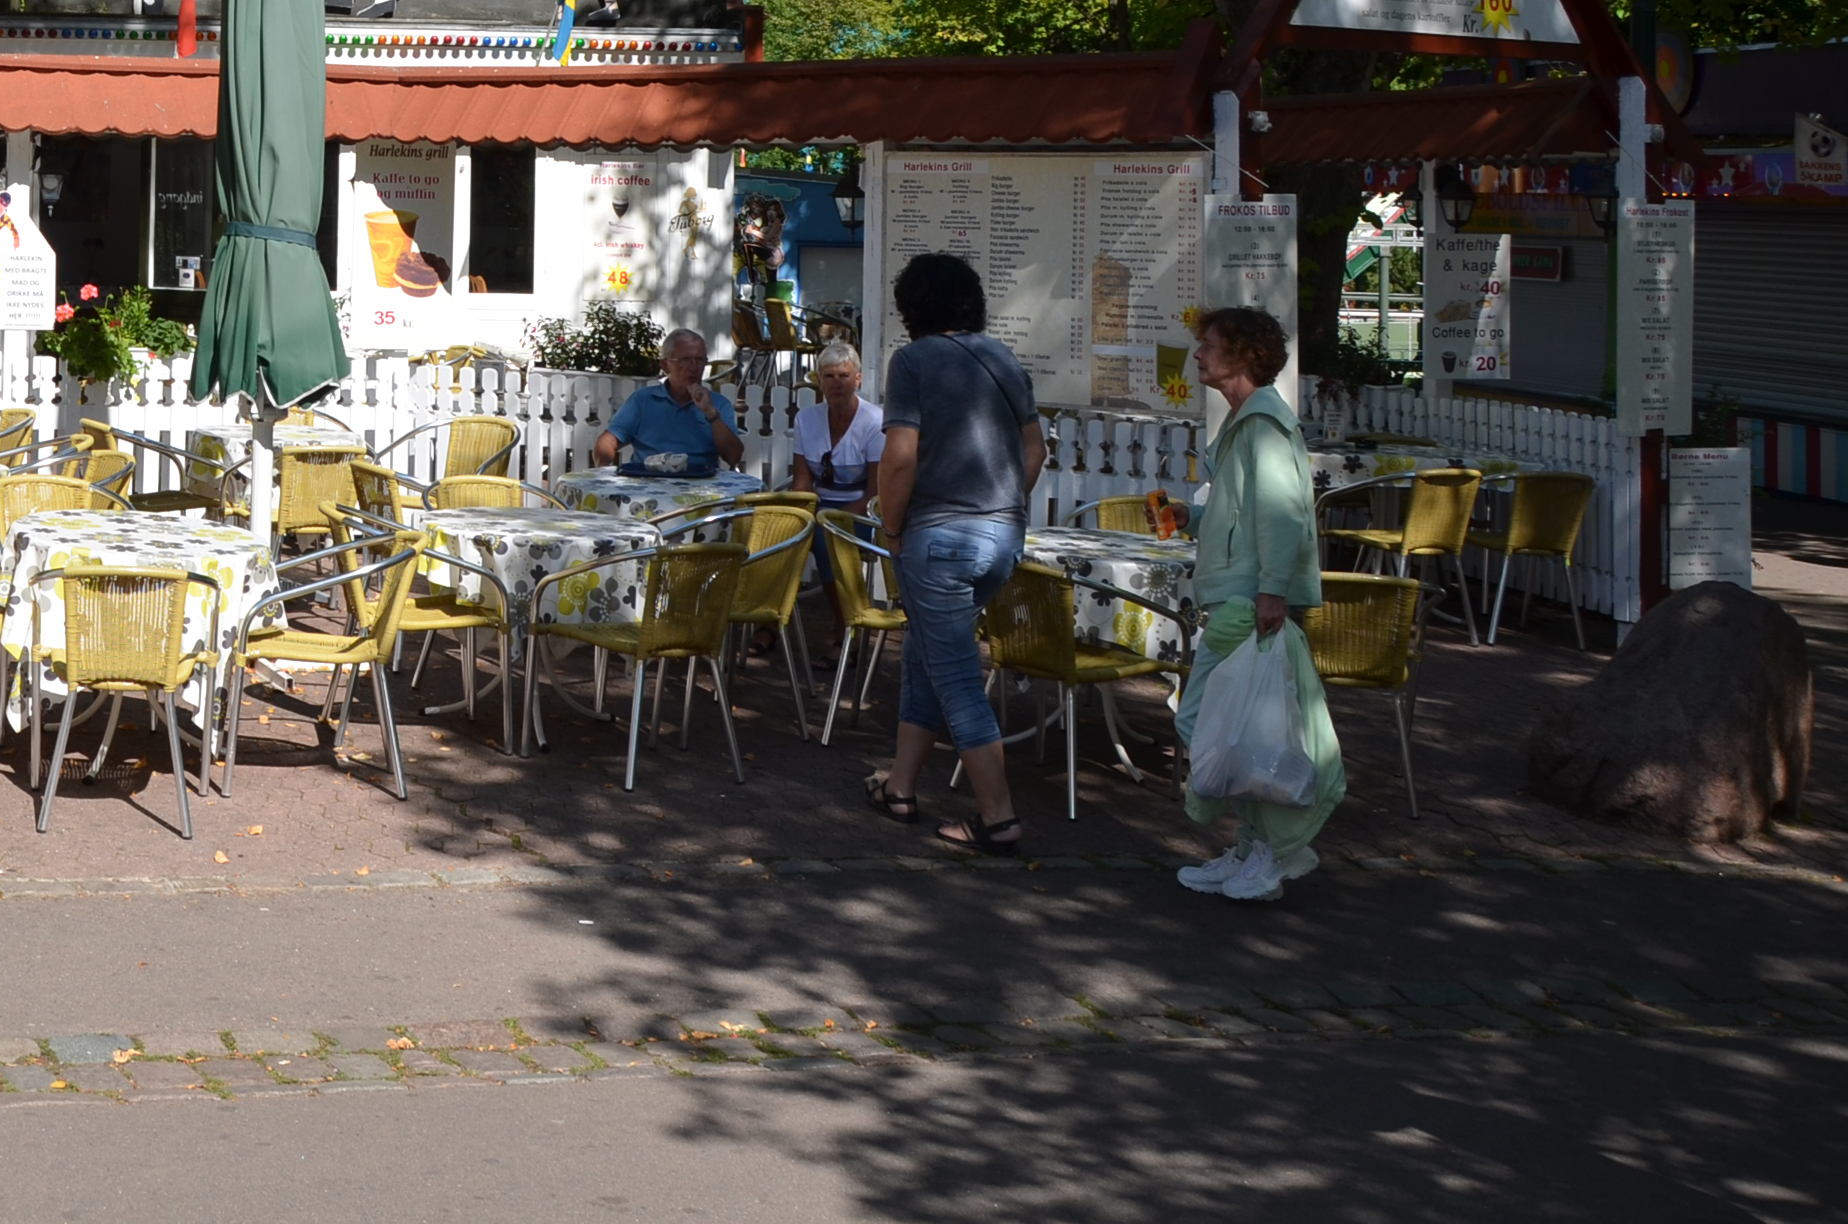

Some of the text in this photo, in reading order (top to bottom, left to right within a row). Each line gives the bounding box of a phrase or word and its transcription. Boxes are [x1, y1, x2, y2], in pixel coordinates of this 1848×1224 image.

[1362, 8, 1378, 17] salat
[1380, 11, 1390, 20] og
[1391, 11, 1416, 22] dagens
[1462, 14, 1479, 33] Kr.
[369, 144, 449, 161] Harlekins grill
[904, 162, 972, 171] Harlekins Grill
[1113, 164, 1190, 174] Harlekins Grill
[373, 173, 440, 186] Kaffe to go
[591, 175, 651, 186] irish coffee
[377, 188, 436, 200] og muffin
[1218, 205, 1290, 216] FROKOS TILBUD
[1626, 207, 1689, 216] Harlekins Frokost
[668, 214, 715, 233] Tuborg
[1436, 238, 1500, 252] Kaffe/the
[1443, 259, 1497, 273] & kage
[607, 271, 628, 284] 48
[1480, 281, 1501, 295] 40
[374, 311, 396, 325] 35
[1432, 327, 1505, 341] Coffee to go
[1475, 356, 1497, 371] 20
[1166, 384, 1188, 399] 40
